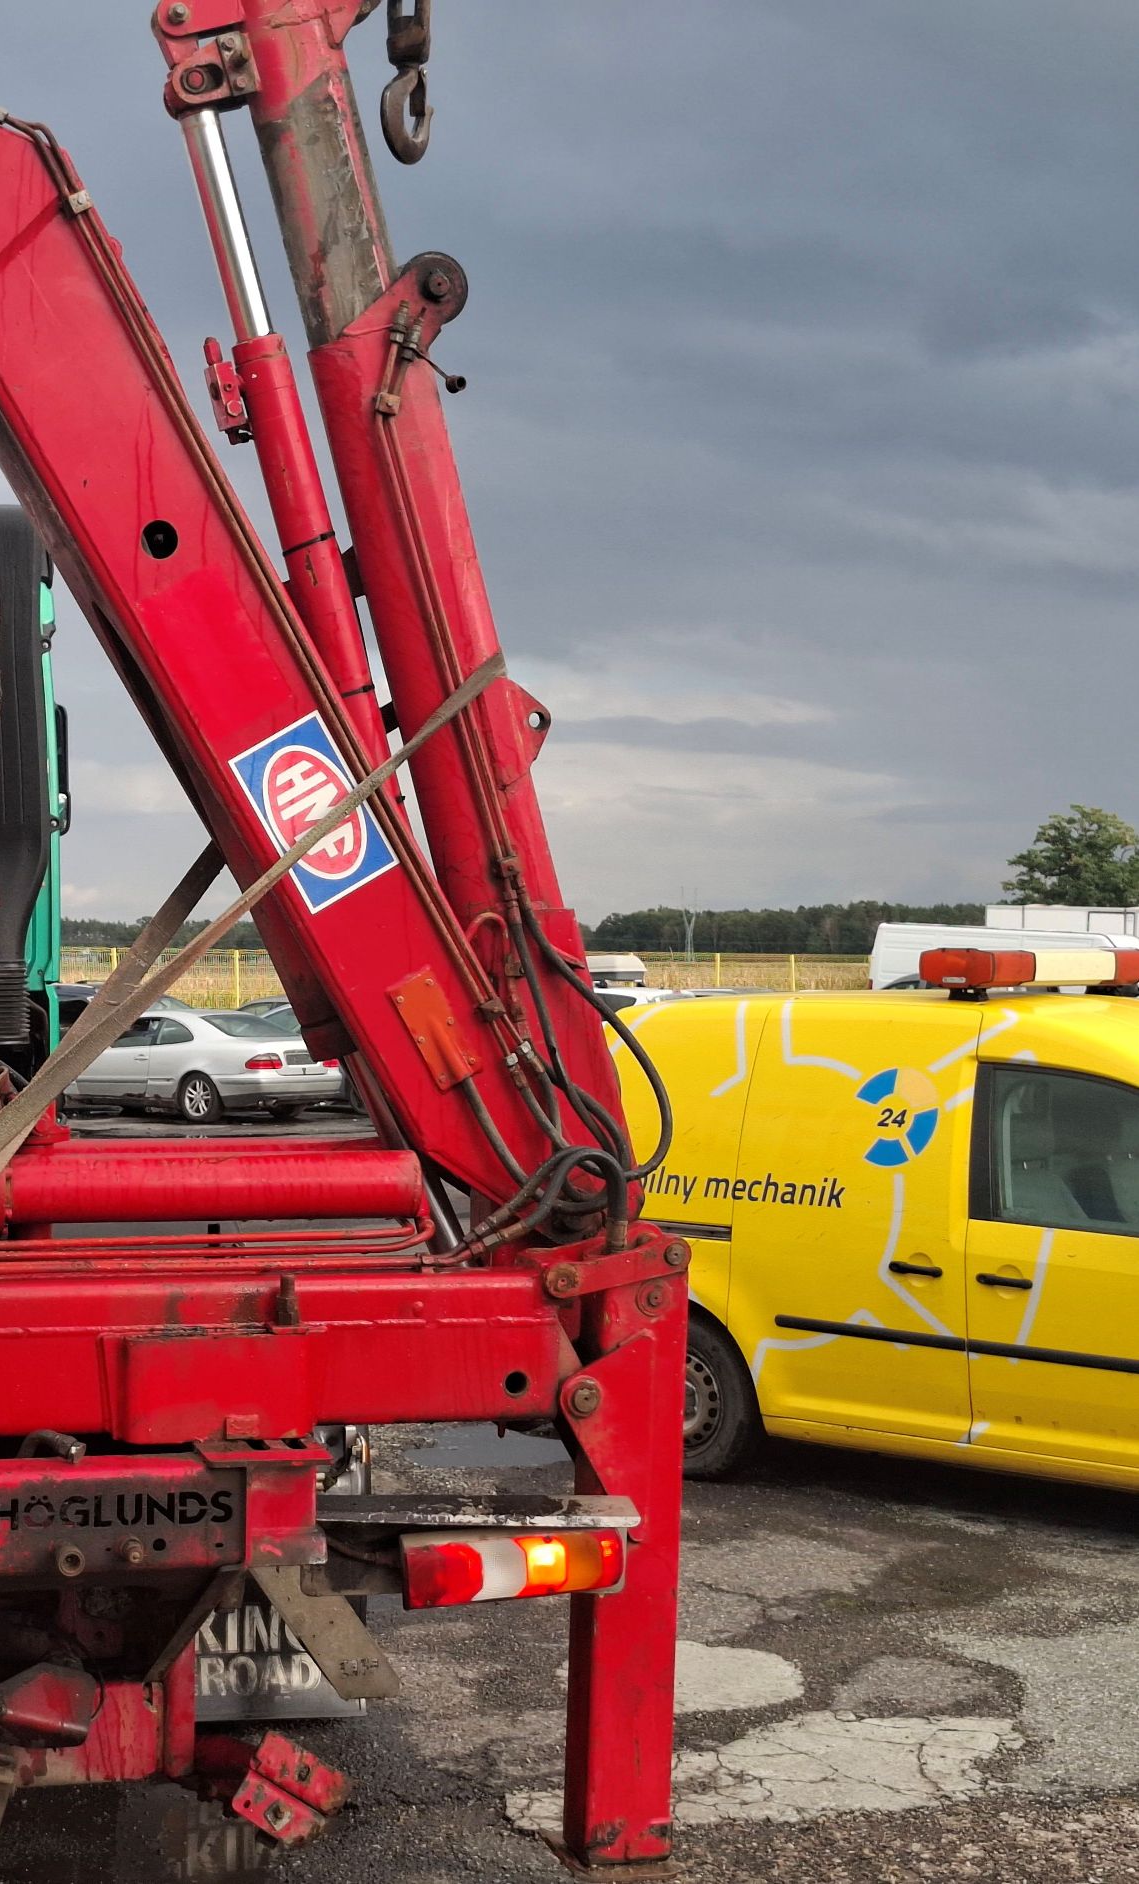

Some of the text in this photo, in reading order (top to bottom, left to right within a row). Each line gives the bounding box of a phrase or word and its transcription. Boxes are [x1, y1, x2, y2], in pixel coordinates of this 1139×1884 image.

[877, 1108, 907, 1128] 24
[703, 1173, 846, 1208] mechanik
[200, 1652, 322, 1696] ROAD
